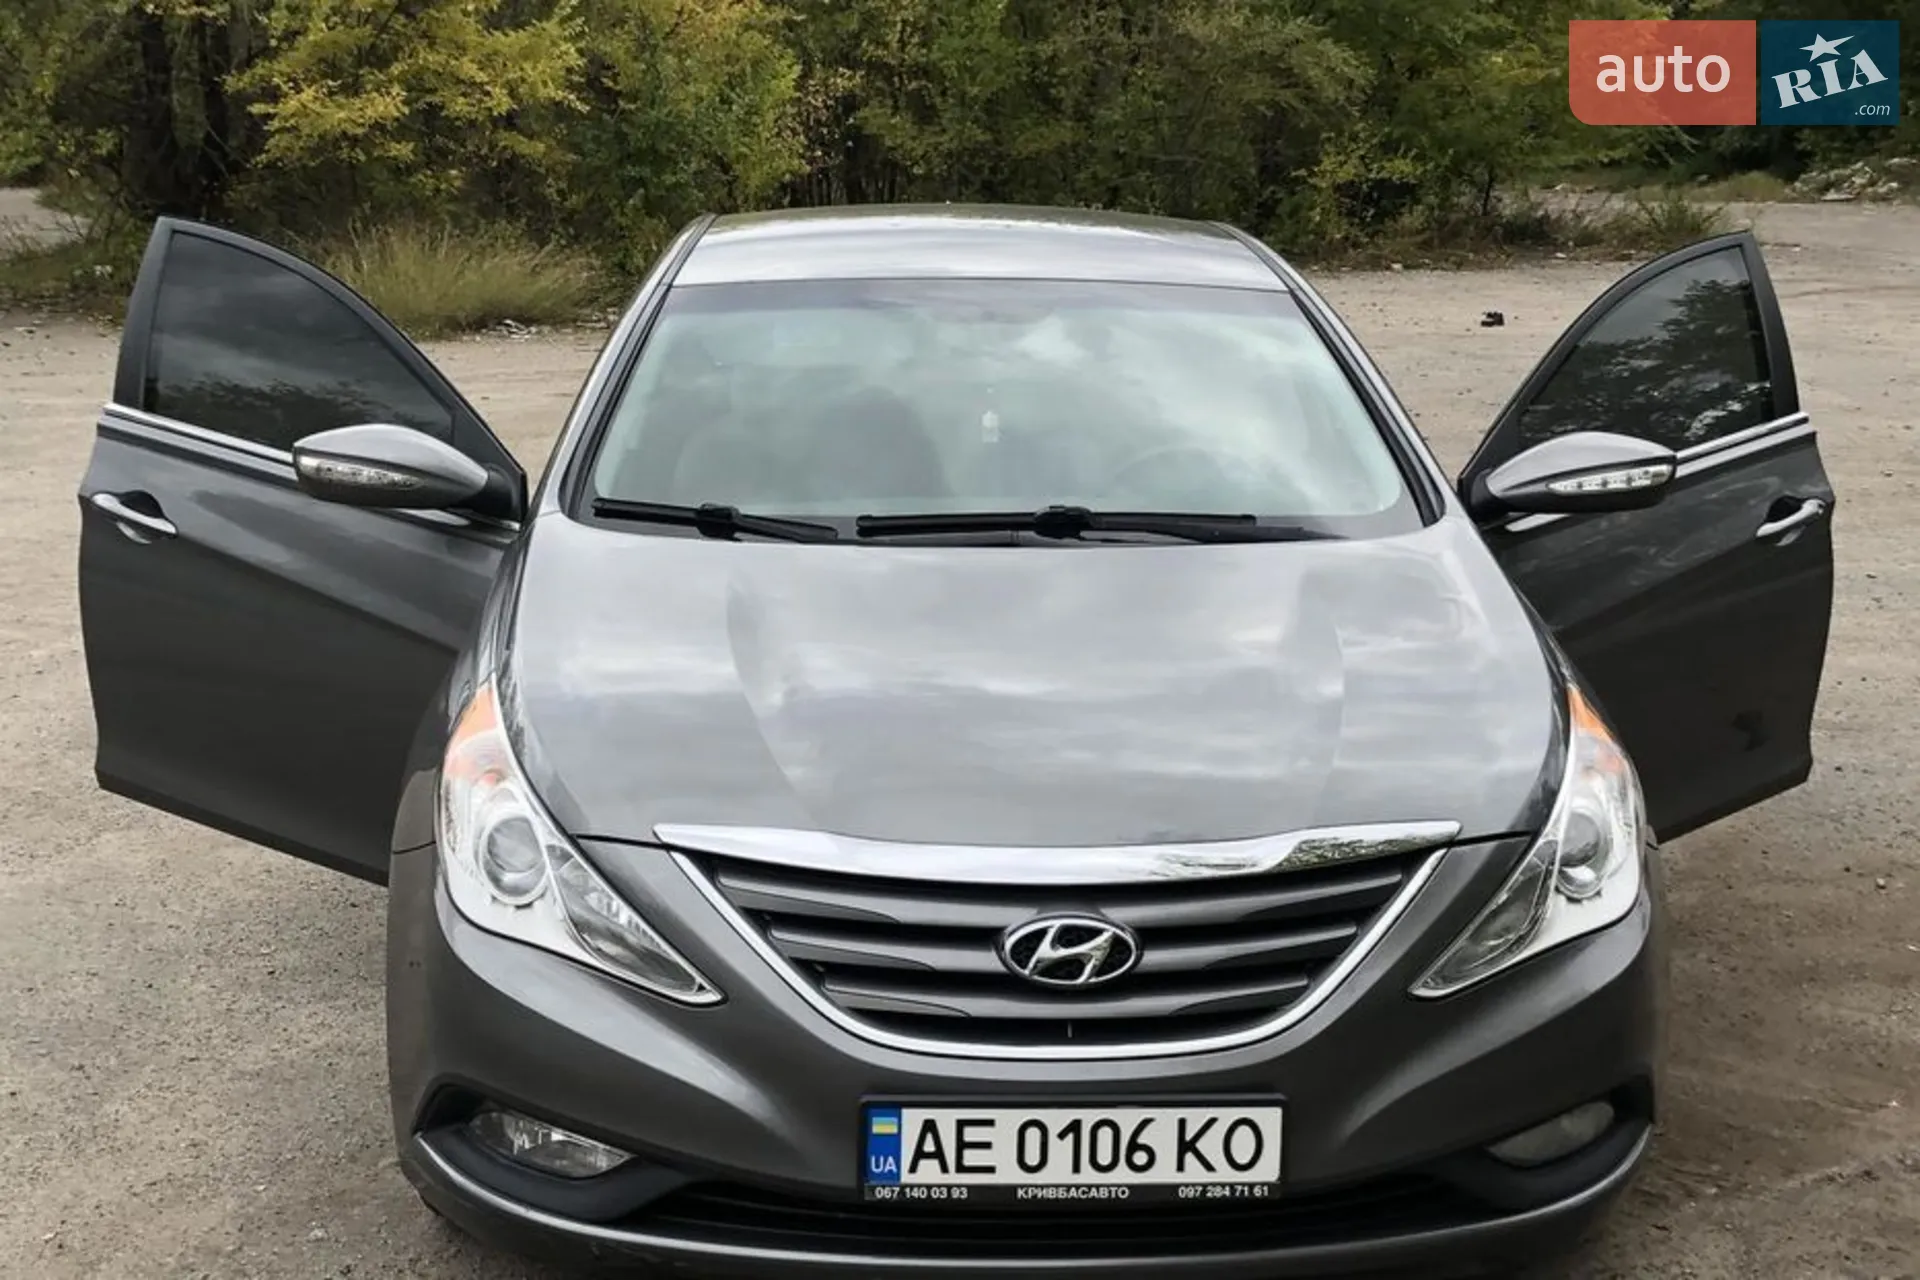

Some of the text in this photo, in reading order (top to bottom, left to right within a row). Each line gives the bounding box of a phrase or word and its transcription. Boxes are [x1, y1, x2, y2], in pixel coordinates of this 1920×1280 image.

[907, 1116, 1265, 1175] AE 0106 KO
[871, 1155, 898, 1173] UA
[875, 1187, 968, 1199] 067 140 03 93
[1017, 1186, 1130, 1199] КРИВБАСАВТО
[1178, 1185, 1269, 1199] 097 284 71 61
